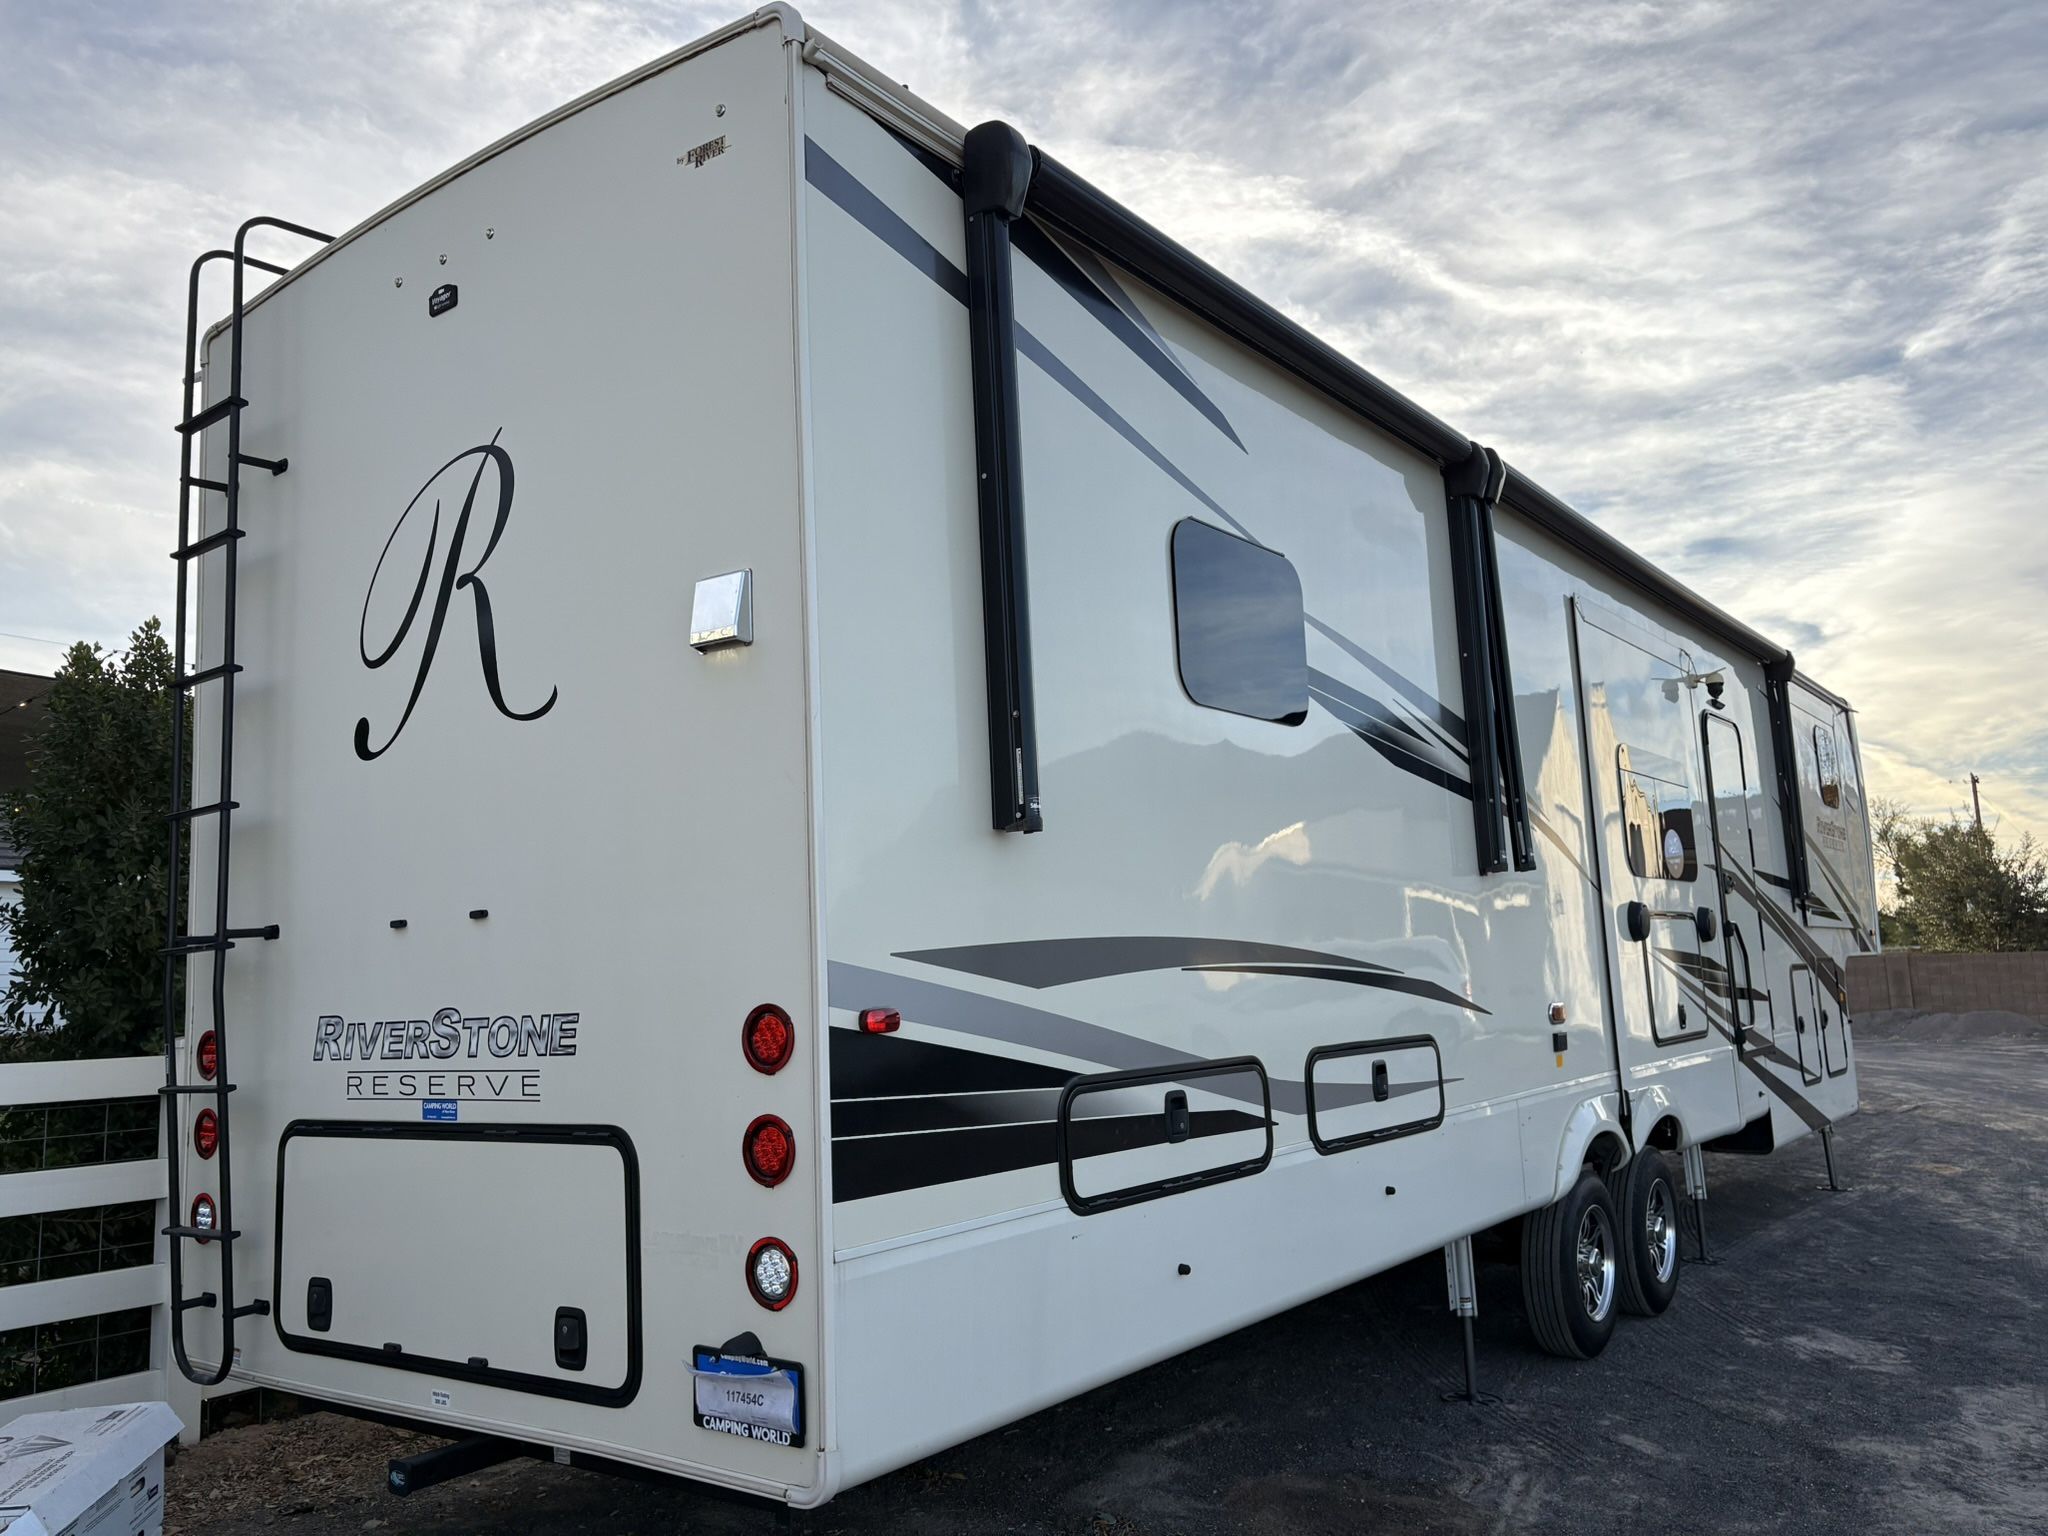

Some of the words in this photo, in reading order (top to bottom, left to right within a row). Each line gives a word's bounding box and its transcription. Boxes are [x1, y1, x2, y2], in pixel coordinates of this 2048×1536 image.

[687, 134, 726, 162] FOREST
[695, 145, 725, 168] RIVER
[354, 427, 557, 761] R
[347, 1074, 541, 1097] RESERVE
[442, 1102, 457, 1110] WORLD
[726, 1390, 765, 1407] 117454C
[703, 1416, 749, 1438] CAMPING
[751, 1424, 791, 1446] WORLD
